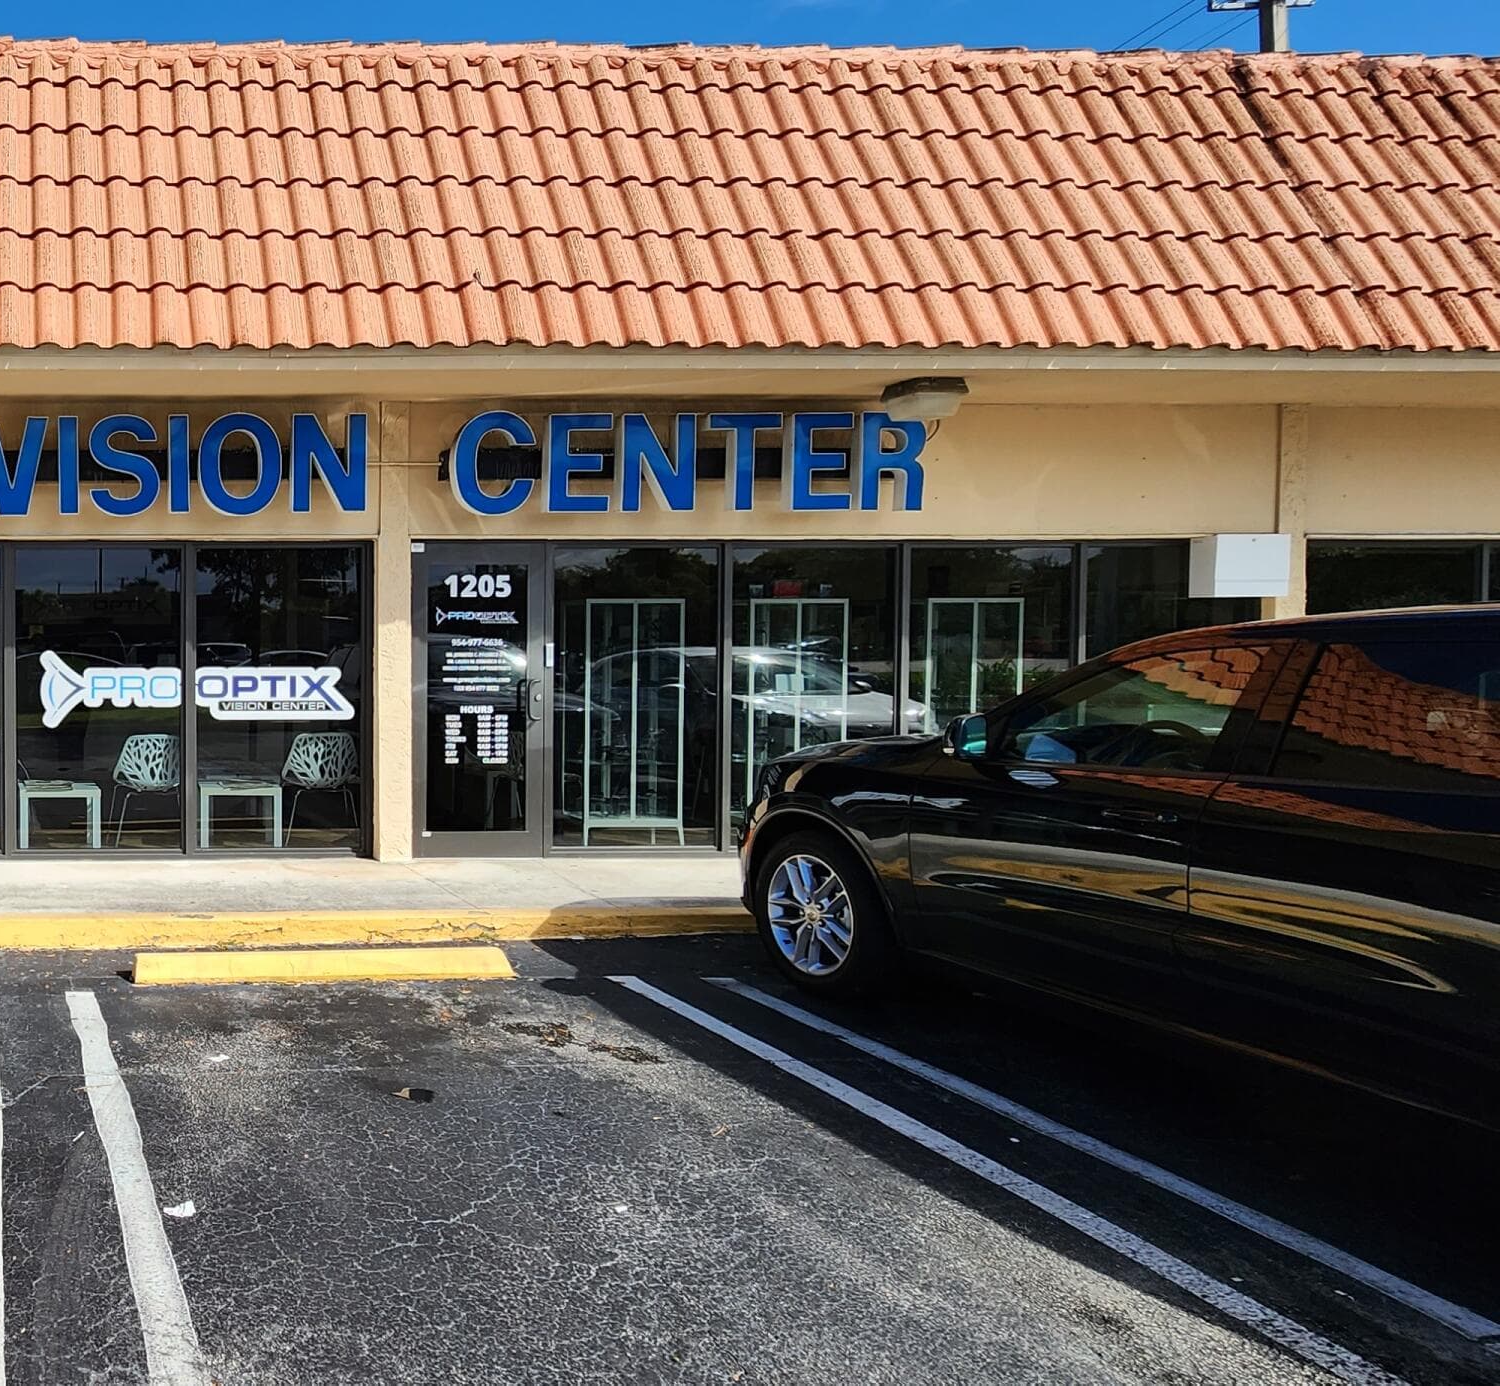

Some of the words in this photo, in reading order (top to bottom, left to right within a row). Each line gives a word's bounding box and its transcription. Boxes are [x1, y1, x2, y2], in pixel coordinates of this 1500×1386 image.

[451, 410, 928, 516] CENTER
[444, 574, 512, 598] 1205
[91, 675, 178, 699] PRO
[198, 675, 344, 711] OPTIX
[221, 701, 268, 711] VISION
[272, 701, 326, 711] CENTER
[460, 705, 494, 714] HOURS
